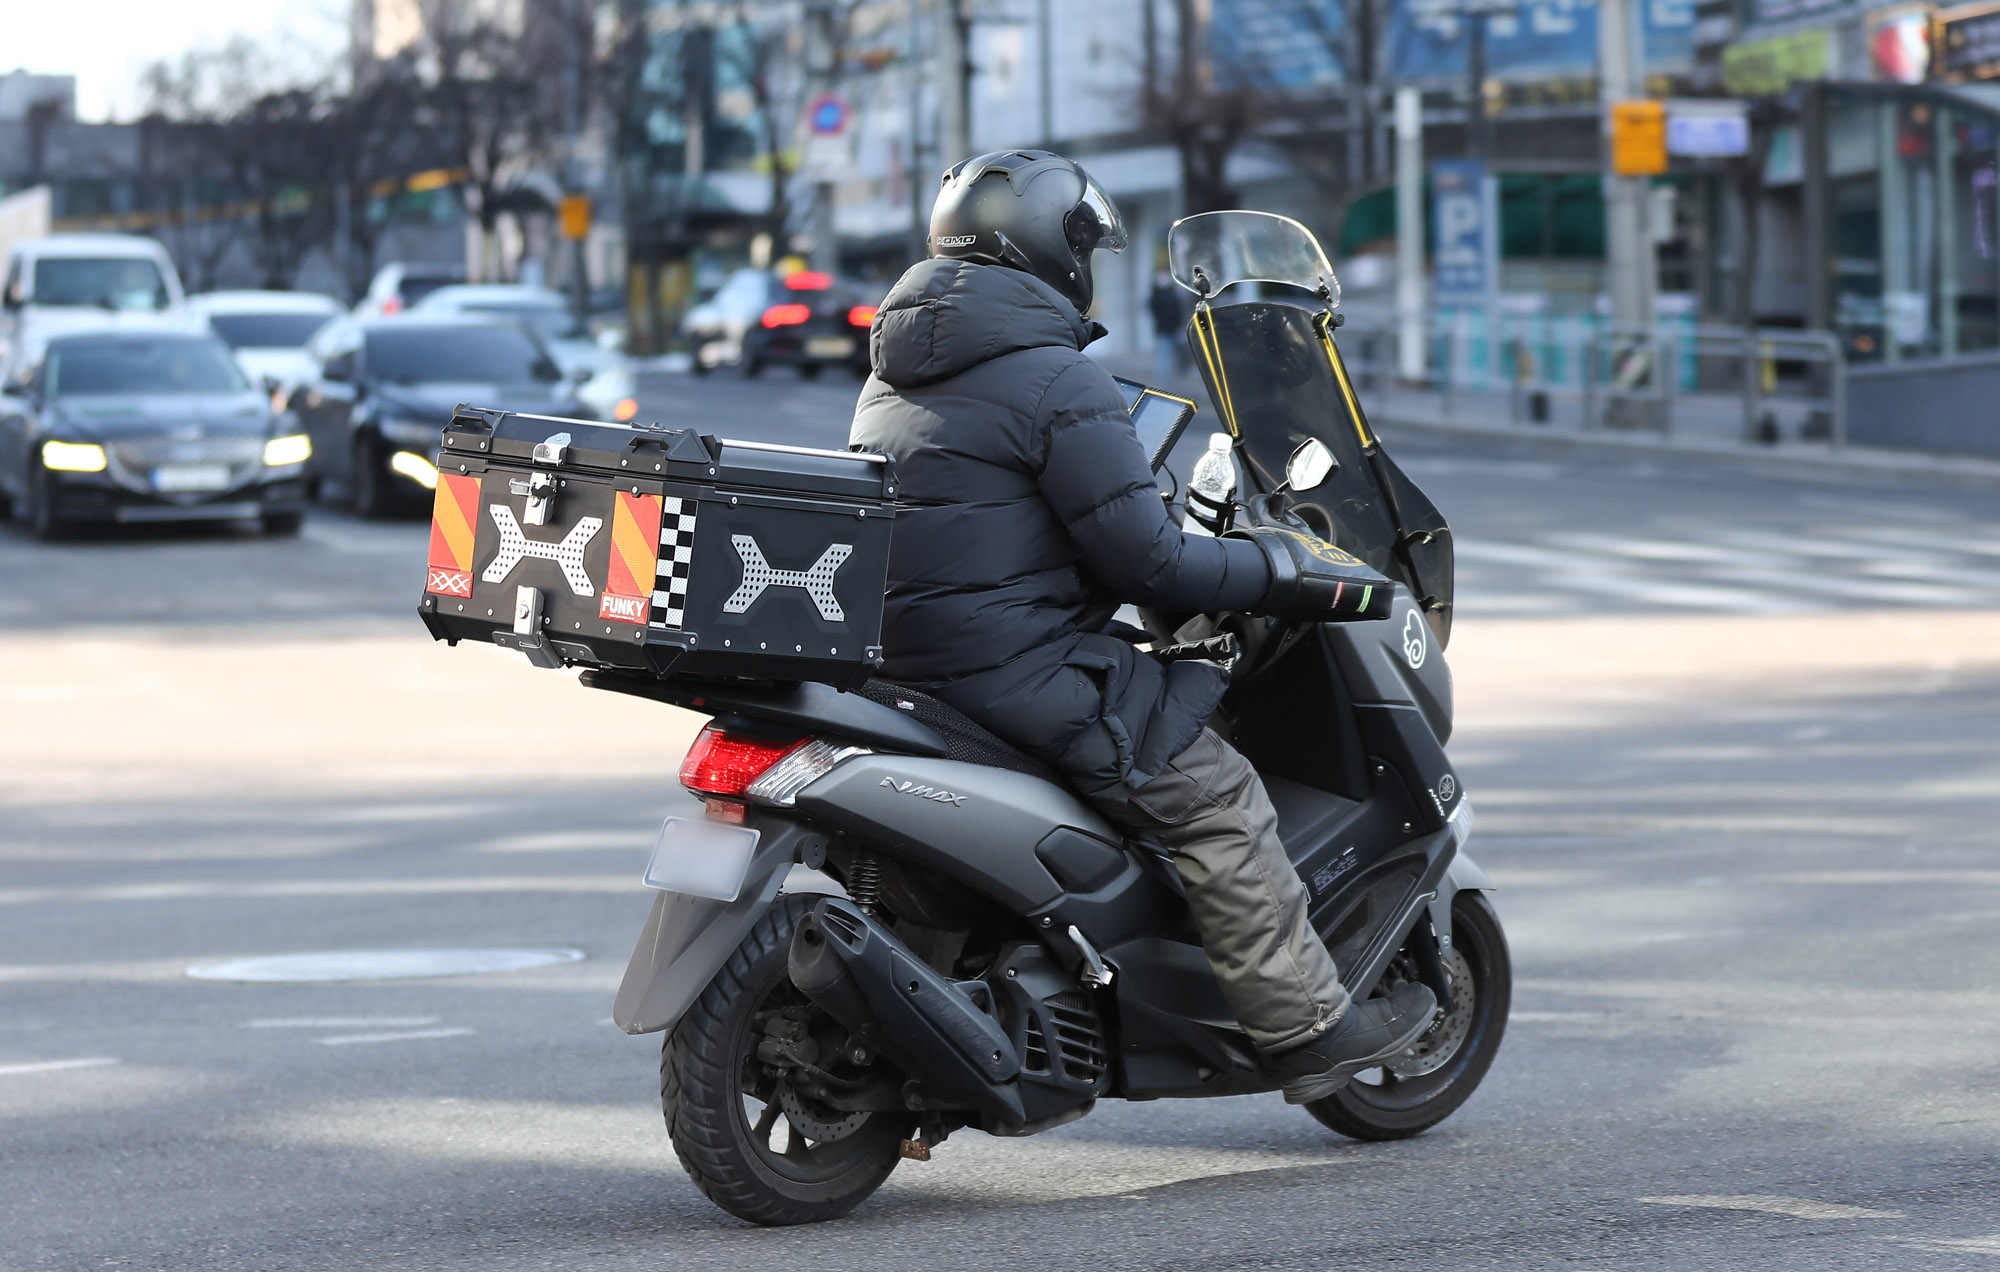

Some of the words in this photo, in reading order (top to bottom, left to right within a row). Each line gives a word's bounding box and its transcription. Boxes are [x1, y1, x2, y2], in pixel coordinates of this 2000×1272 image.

[1442, 194, 1479, 248] P
[936, 235, 977, 246] KOMO
[602, 595, 646, 618] FUNKY
[880, 776, 968, 808] NMAX
